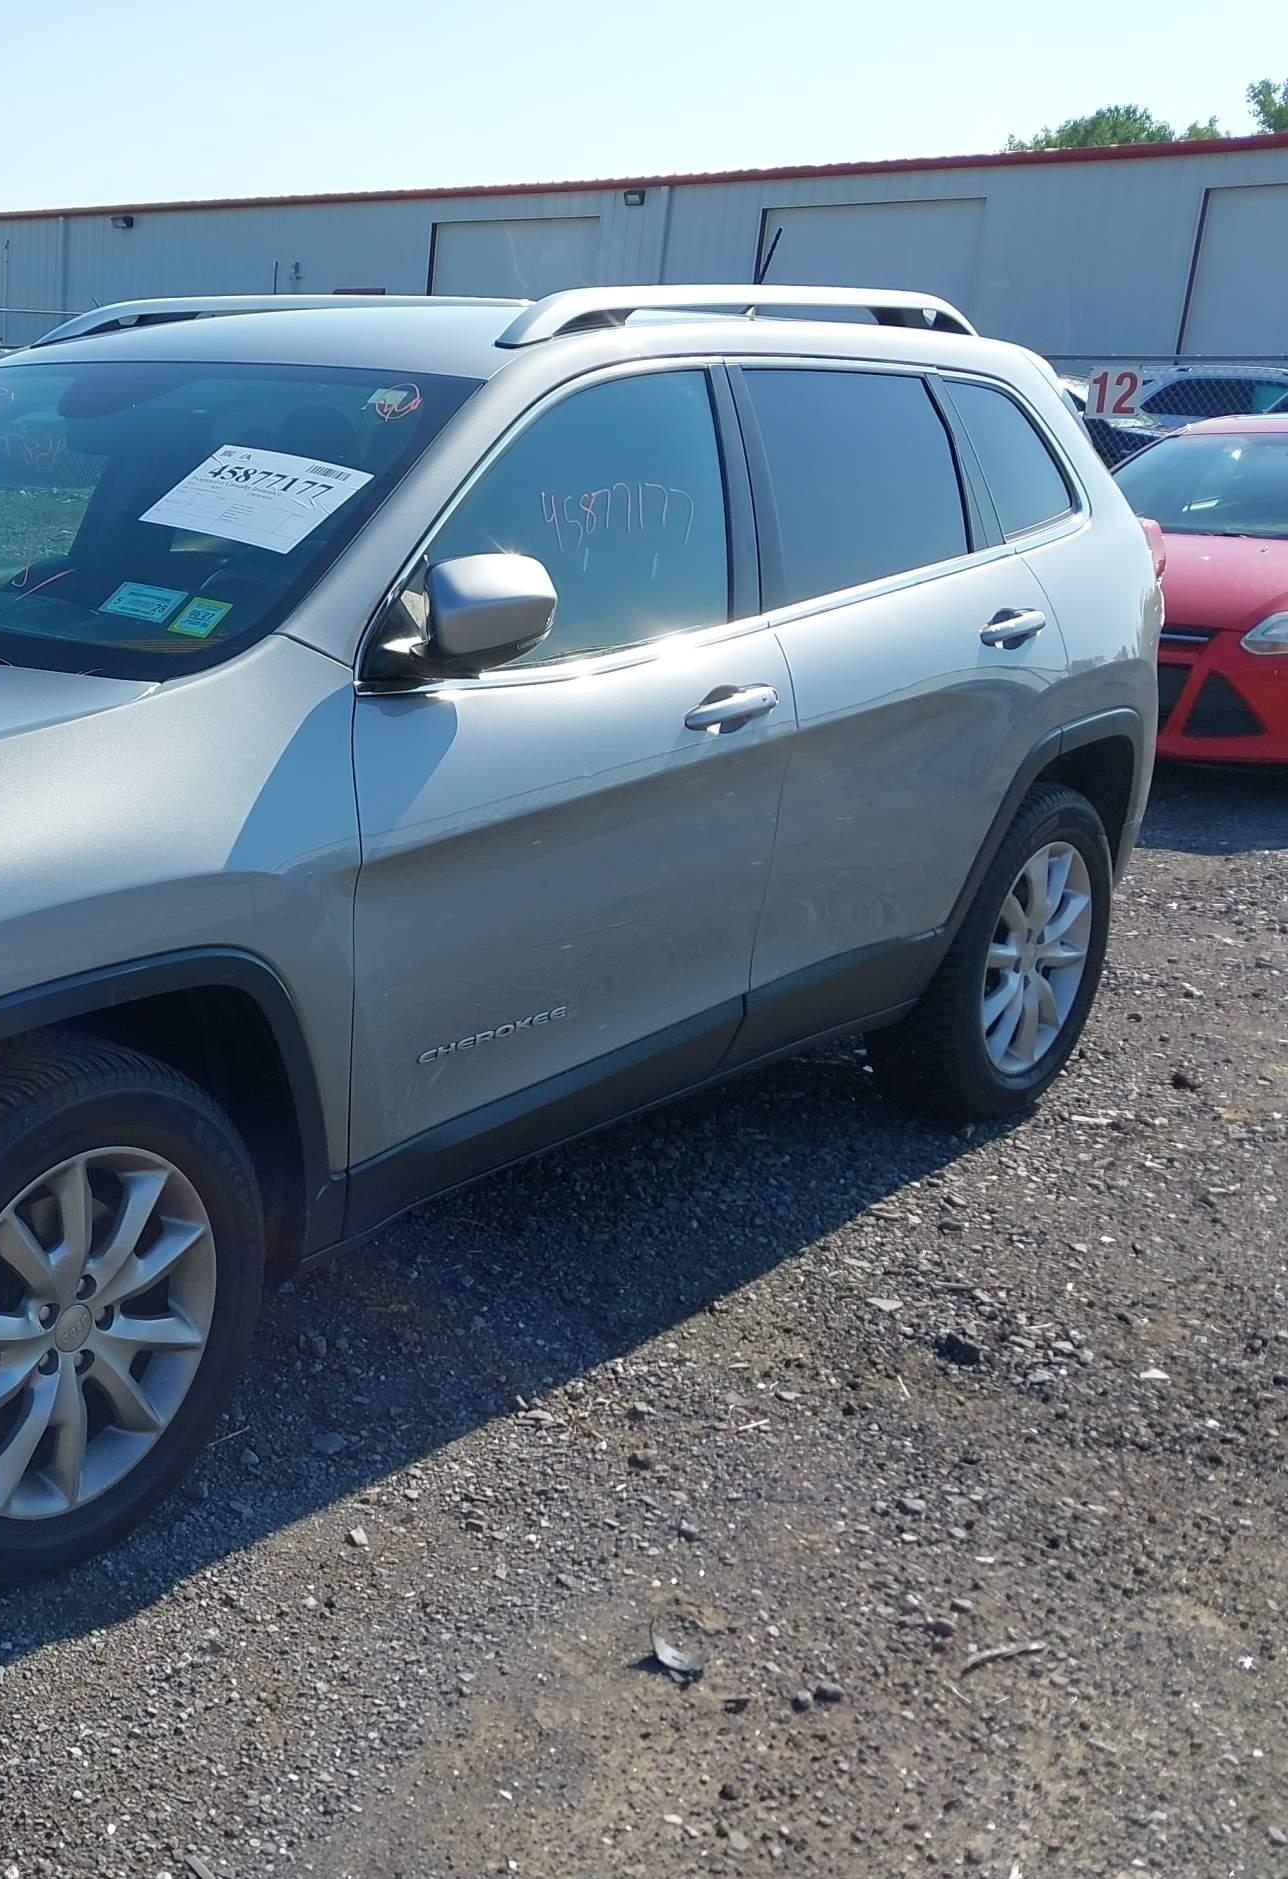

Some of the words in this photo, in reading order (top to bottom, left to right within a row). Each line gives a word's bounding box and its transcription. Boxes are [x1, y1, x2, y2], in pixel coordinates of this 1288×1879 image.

[1093, 371, 1138, 414] 12
[208, 463, 335, 500] 45877177
[540, 482, 694, 553] 45877177
[150, 603, 169, 614] 28
[416, 1005, 568, 1065] CHEROKEE
